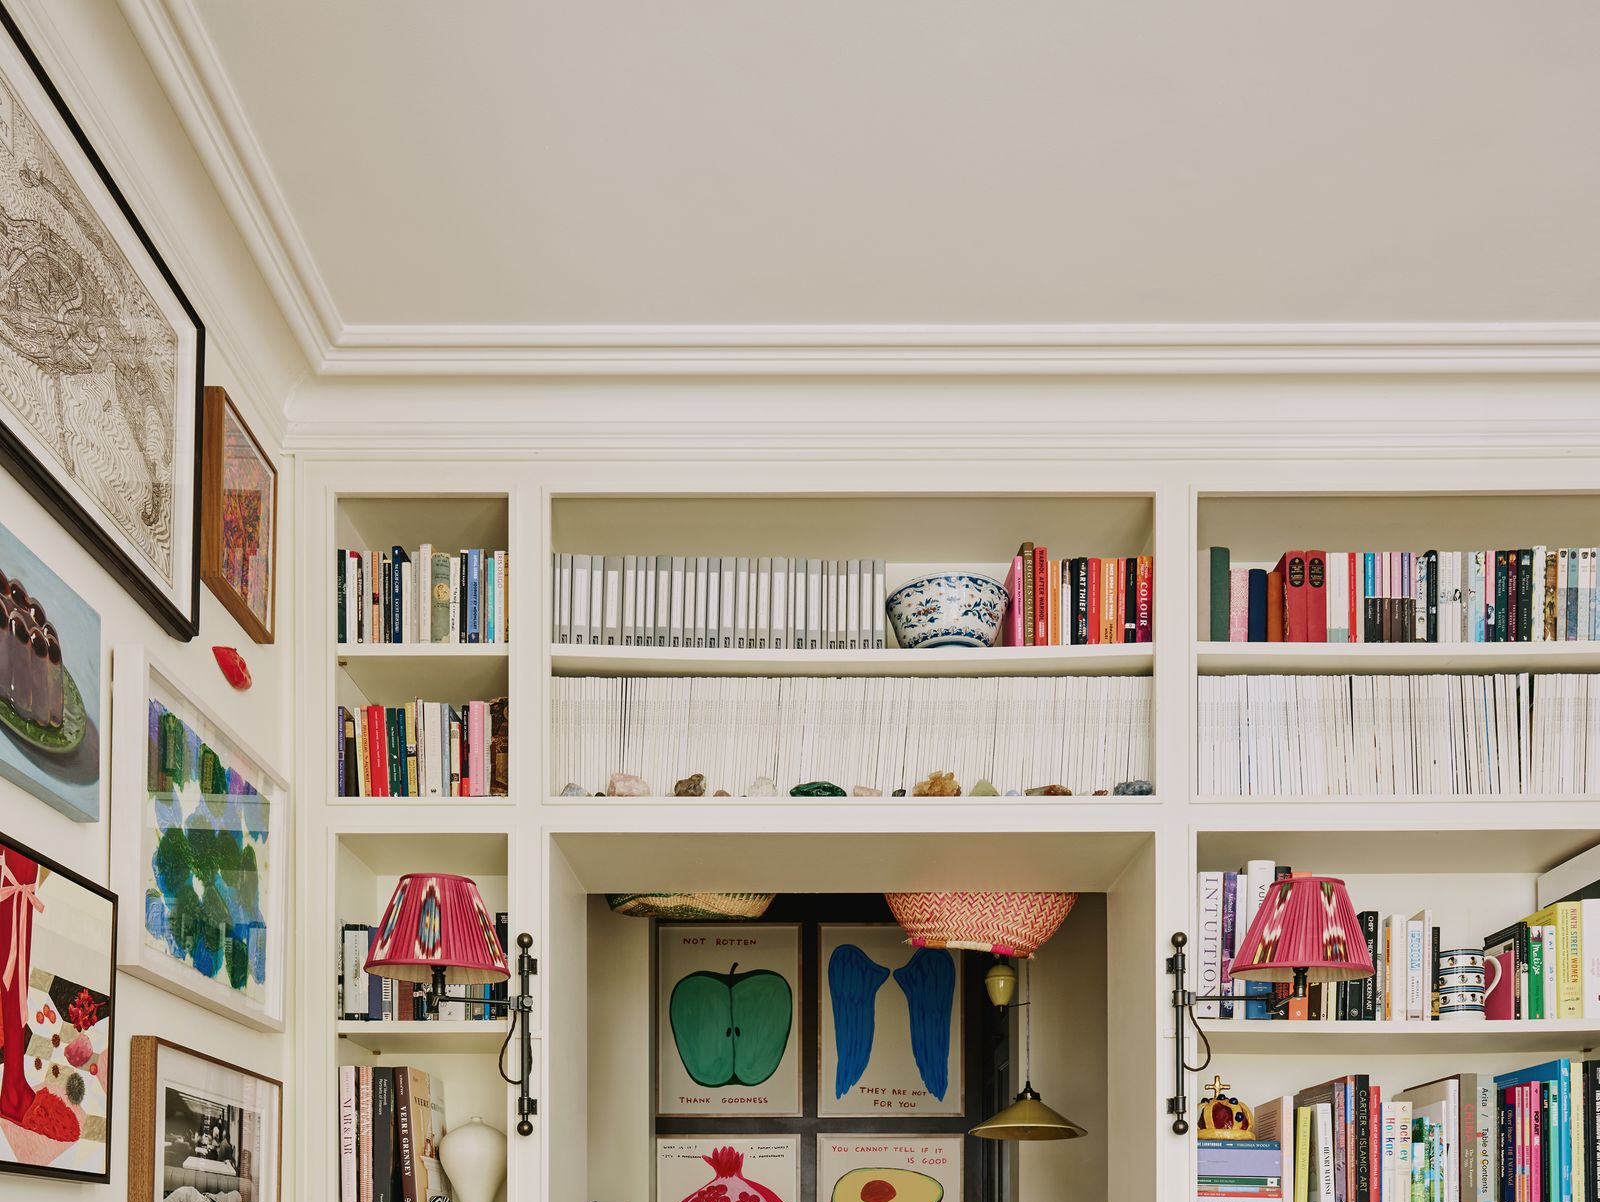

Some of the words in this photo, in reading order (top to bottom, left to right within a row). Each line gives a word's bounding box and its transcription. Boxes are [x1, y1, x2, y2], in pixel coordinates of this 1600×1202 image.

[1140, 582, 1148, 627] COLOUR
[1570, 908, 1578, 929] NINTH
[1204, 877, 1218, 1000] INTUITION
[1570, 931, 1578, 956] STREET
[1532, 944, 1541, 976] Matisse
[1570, 958, 1578, 984] WOMEN
[859, 1086, 887, 1095] THEY
[873, 1099, 892, 1108] FOR
[343, 1127, 352, 1136] &
[400, 1106, 409, 1135] VEERE
[1464, 1103, 1474, 1144] CHINA
[343, 1136, 352, 1155] FAR
[401, 1137, 411, 1178] GRENNEY
[1481, 1149, 1489, 1157] of
